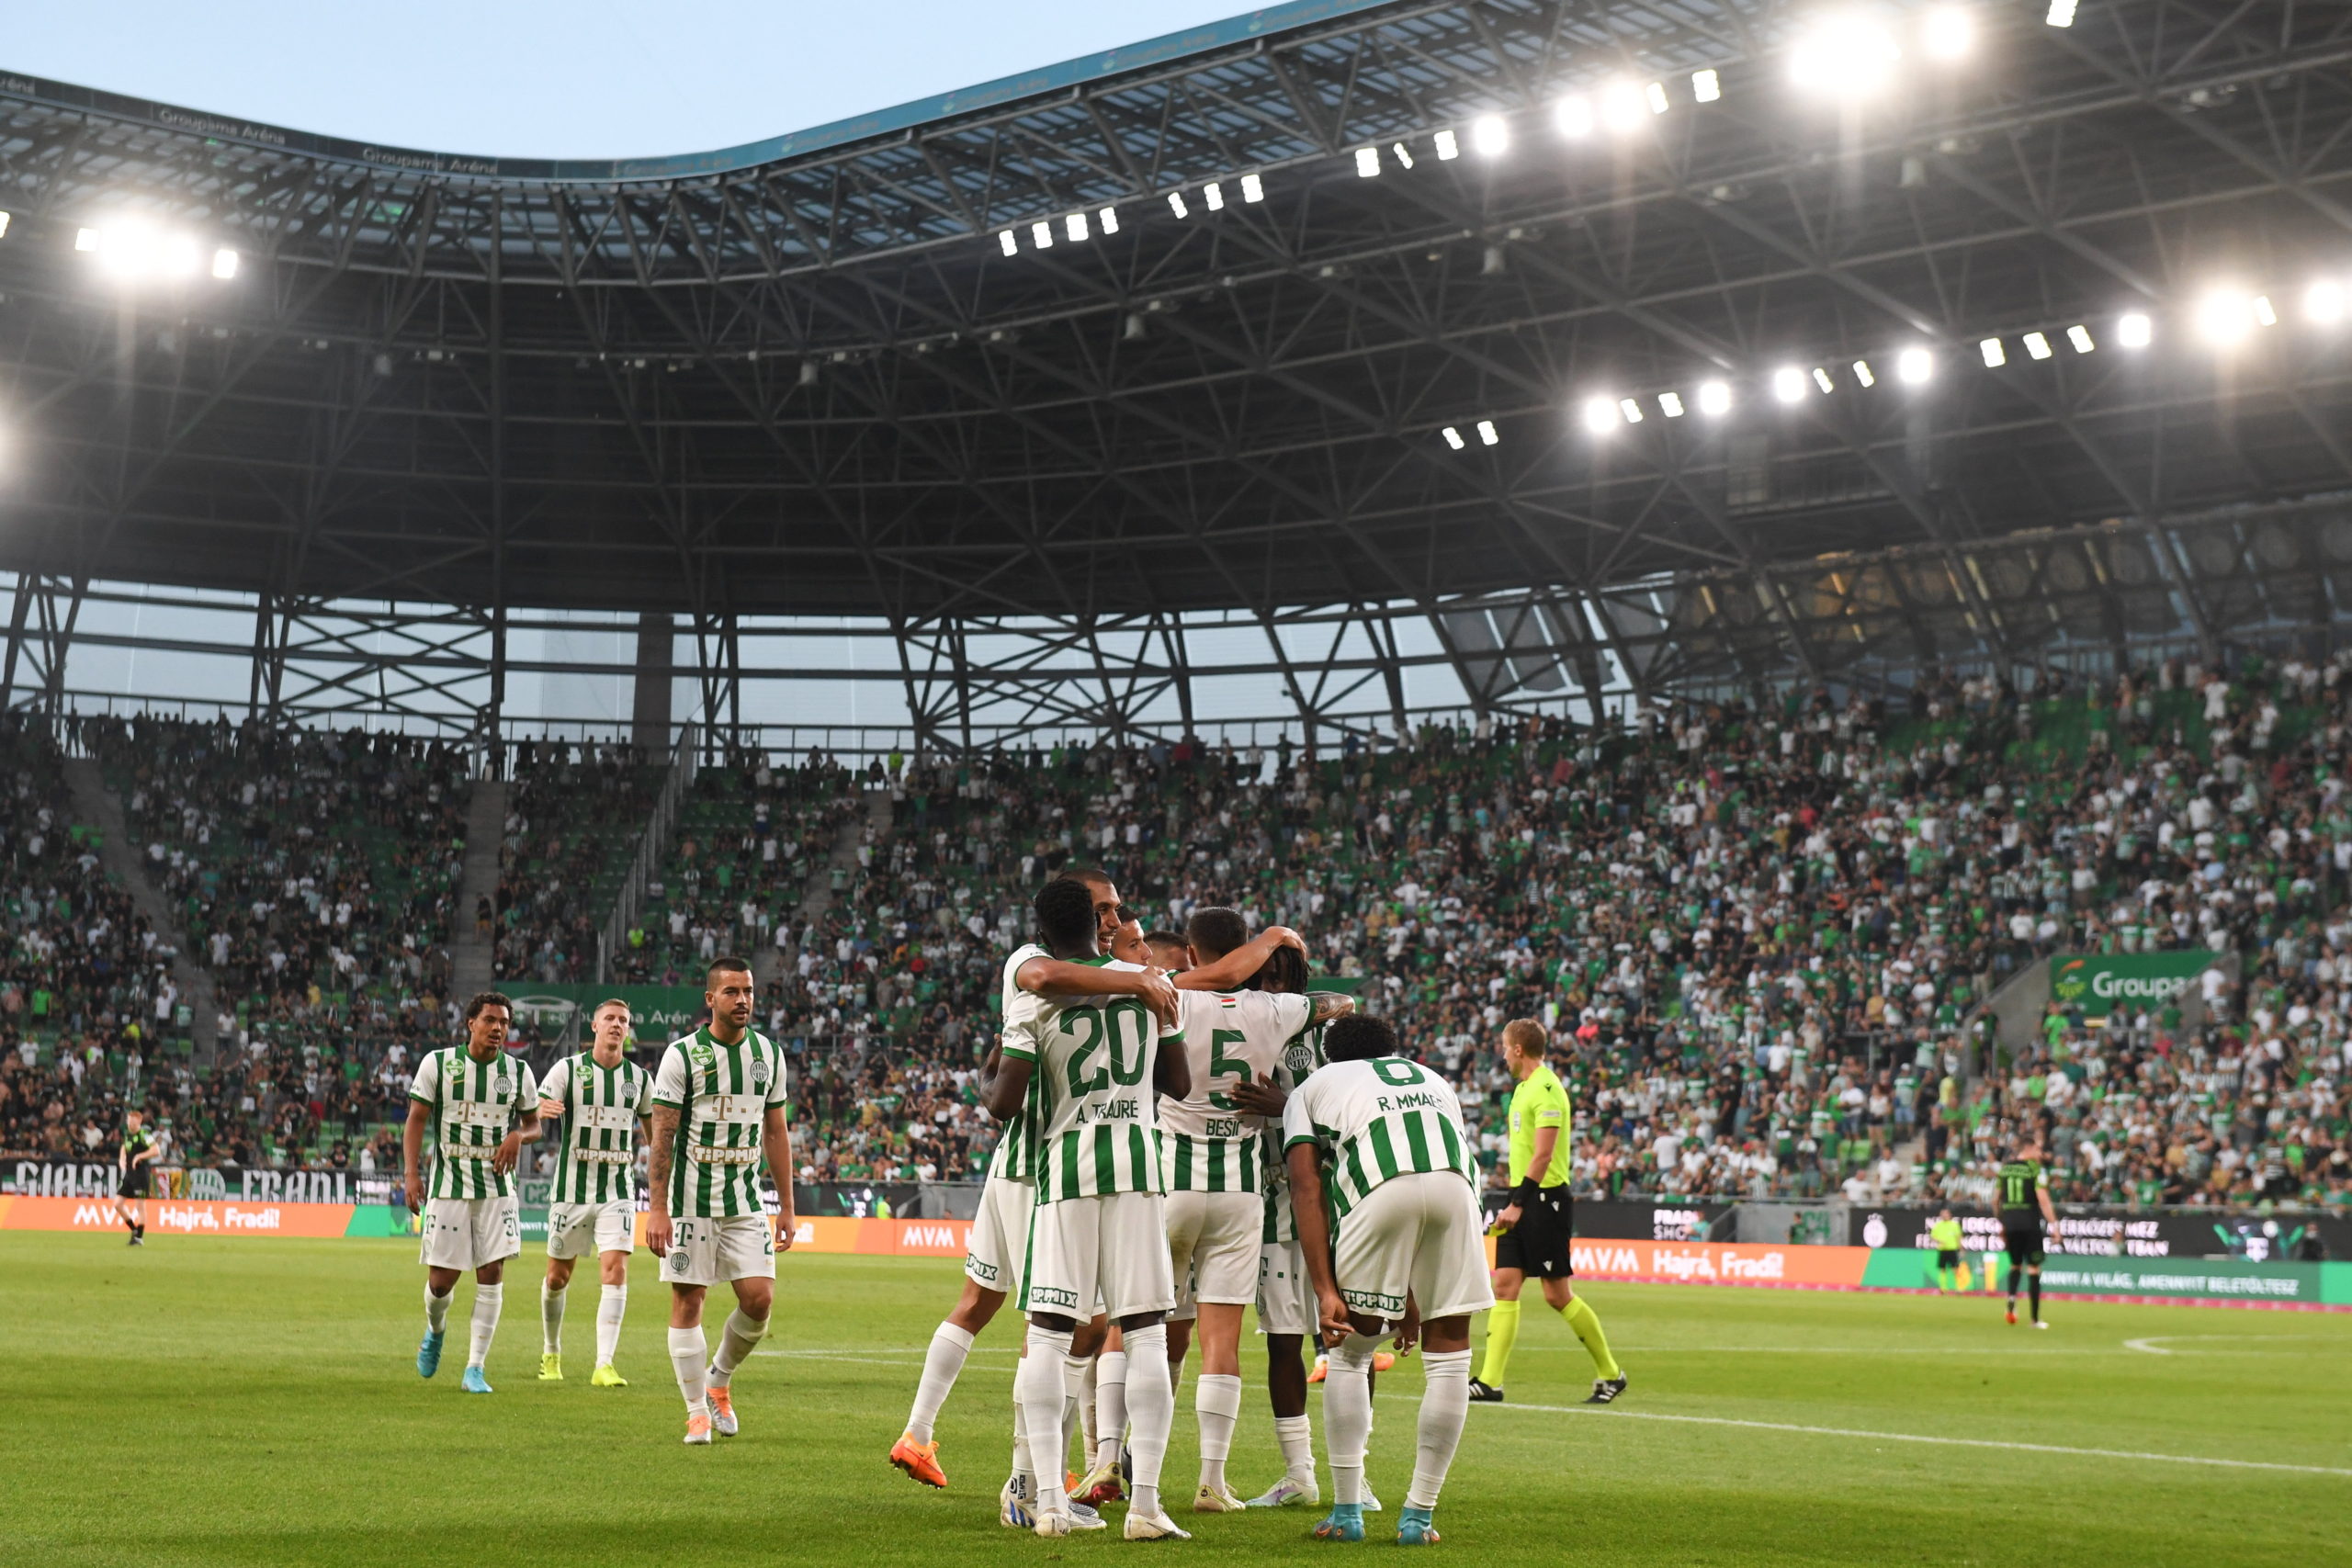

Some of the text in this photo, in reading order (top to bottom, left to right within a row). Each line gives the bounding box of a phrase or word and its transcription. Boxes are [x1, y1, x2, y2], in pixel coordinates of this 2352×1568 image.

[2092, 971, 2187, 1002] Groupa
[650, 1009, 692, 1024] Arén
[1059, 998, 1148, 1099] 20
[1209, 1029, 1251, 1111] 5
[1075, 1104, 1089, 1124] A.
[1376, 1097, 1395, 1111] R.
[623, 1216, 631, 1235] 4
[1654, 1225, 1689, 1241] SHO
[902, 1226, 955, 1247] MVM
[1570, 1247, 1639, 1272] MVM
